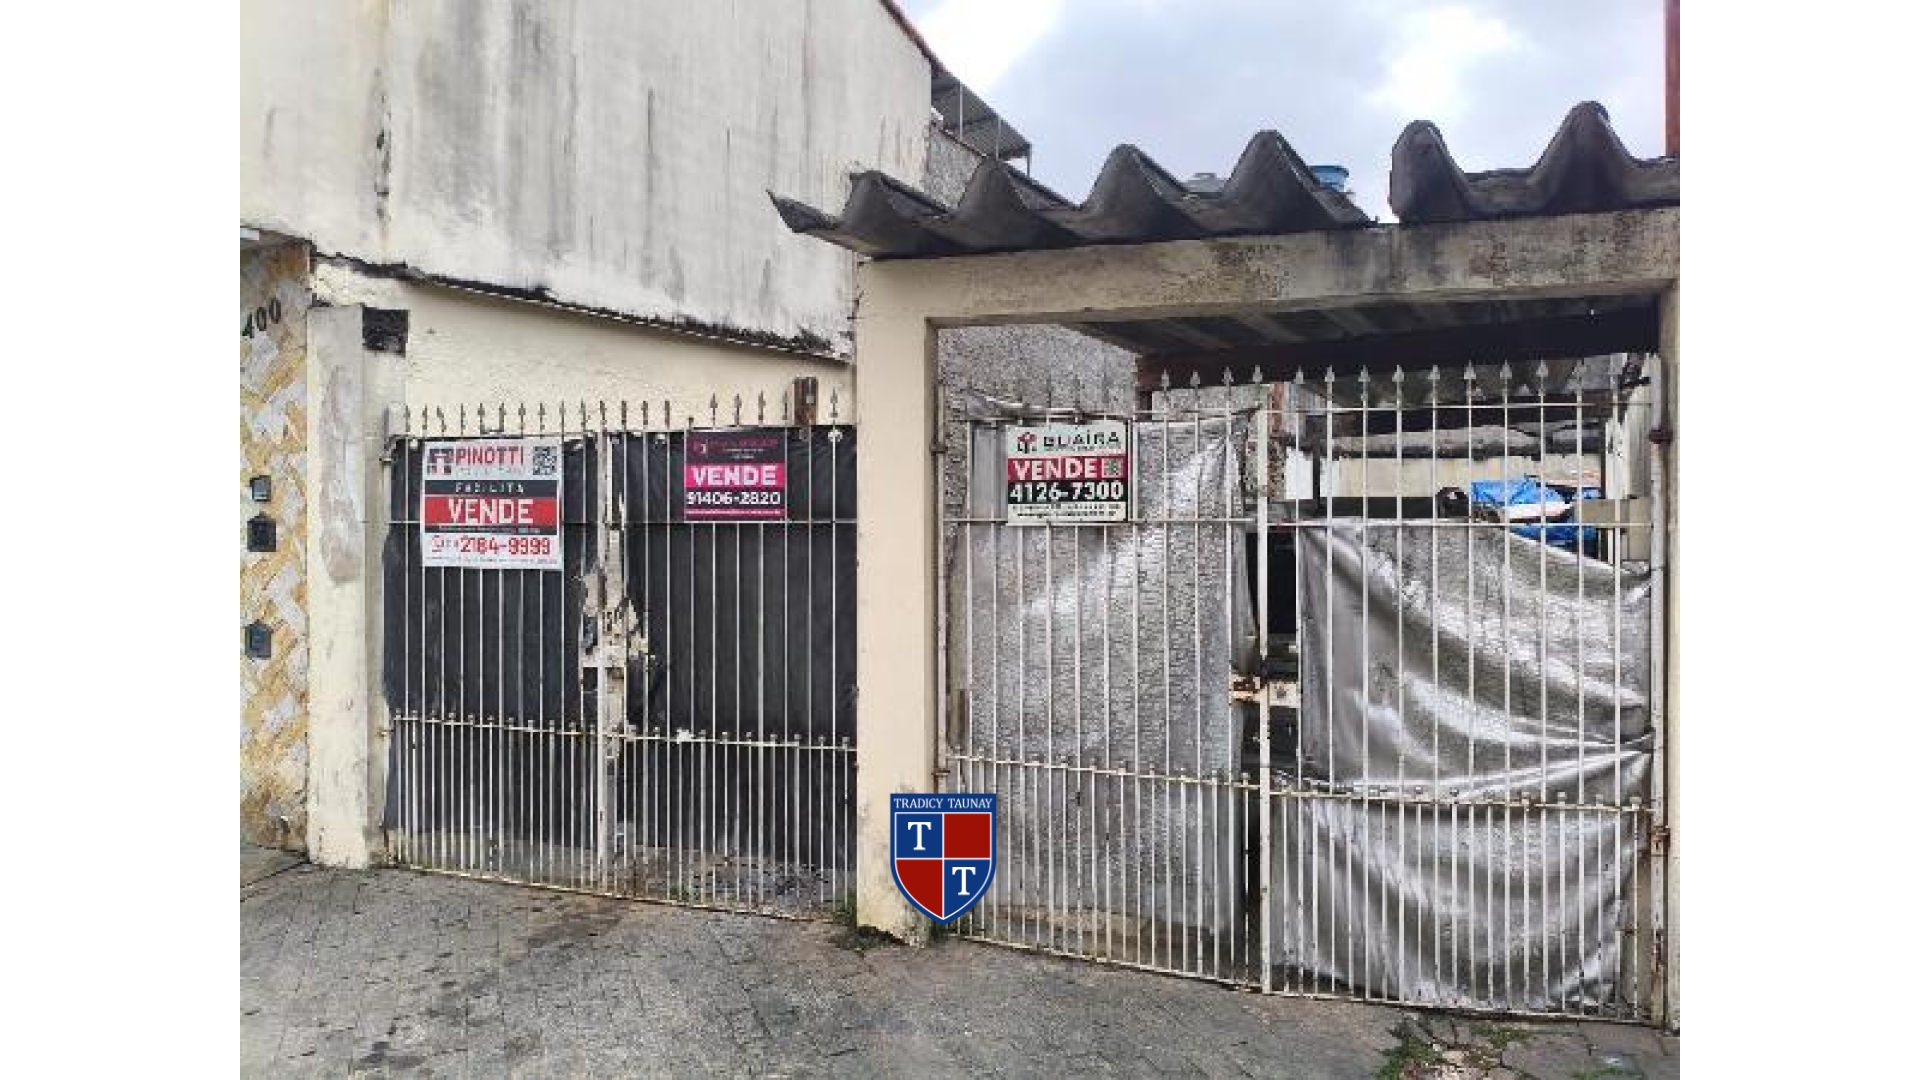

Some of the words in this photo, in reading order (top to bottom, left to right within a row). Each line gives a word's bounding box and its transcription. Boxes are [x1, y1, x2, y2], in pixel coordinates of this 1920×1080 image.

[242, 298, 281, 338] 400
[456, 446, 524, 466] PINOTTI
[691, 465, 776, 486] VENDE
[1012, 458, 1098, 480] VENDE
[686, 491, 781, 505] 91406-2820
[1010, 481, 1124, 502] 4126-7300
[448, 498, 534, 524] VENDE
